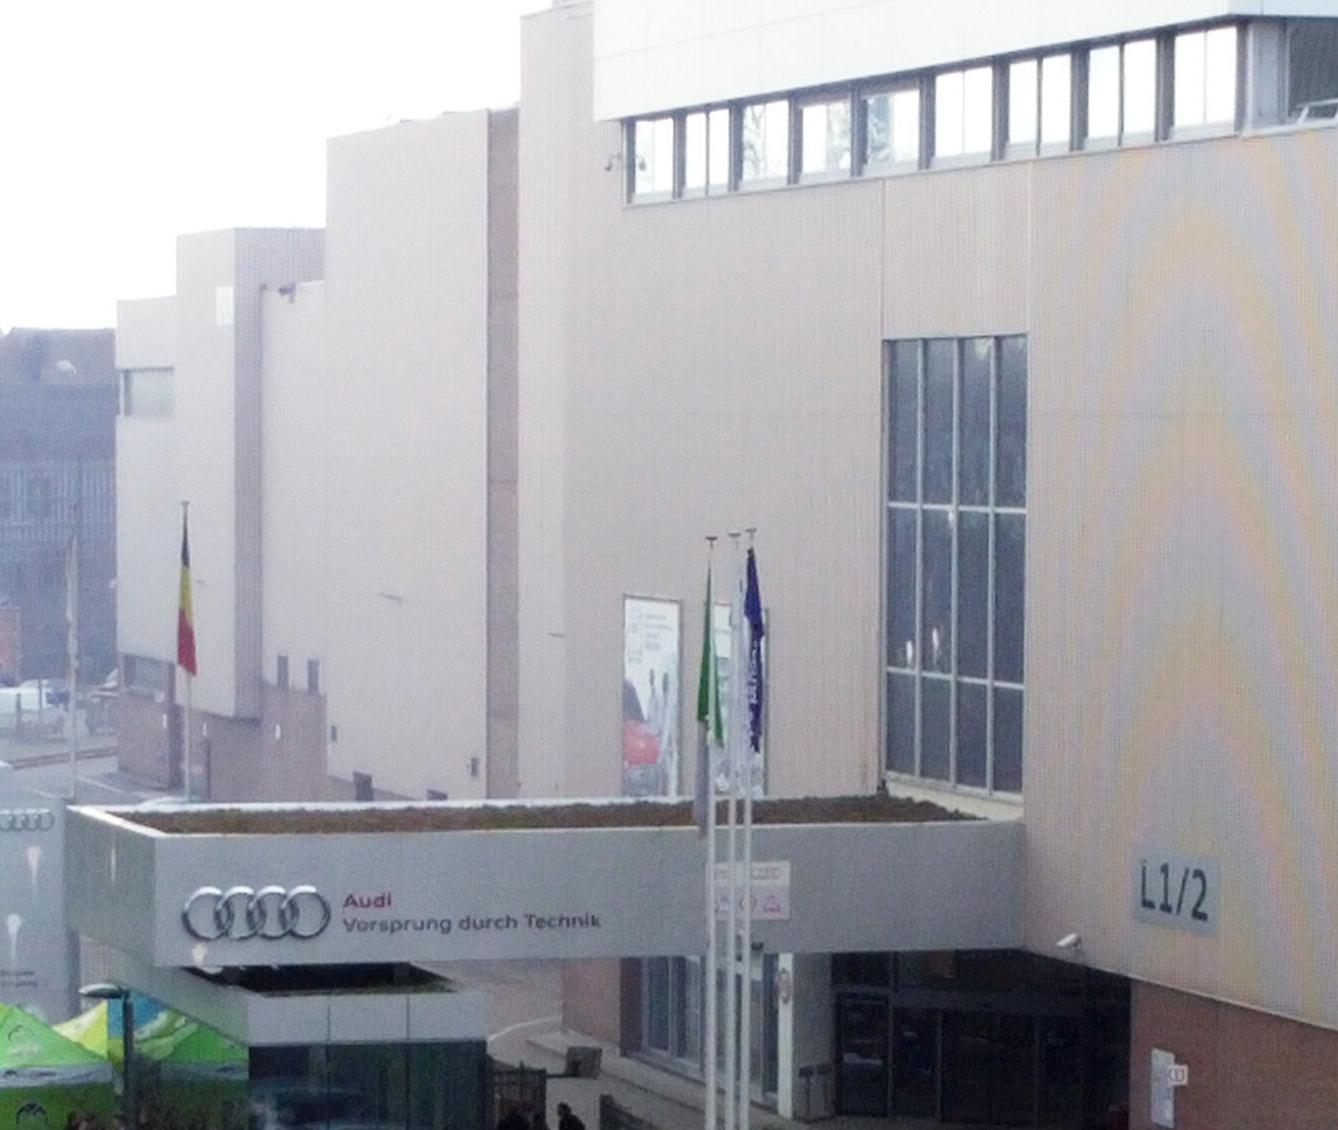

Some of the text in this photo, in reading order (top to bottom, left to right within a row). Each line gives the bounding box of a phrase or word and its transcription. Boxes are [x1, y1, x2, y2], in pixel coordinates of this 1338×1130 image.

[342, 892, 393, 909] Audi
[1141, 861, 1209, 922] L1/2
[342, 912, 602, 935] Vorsprung durch Technik
